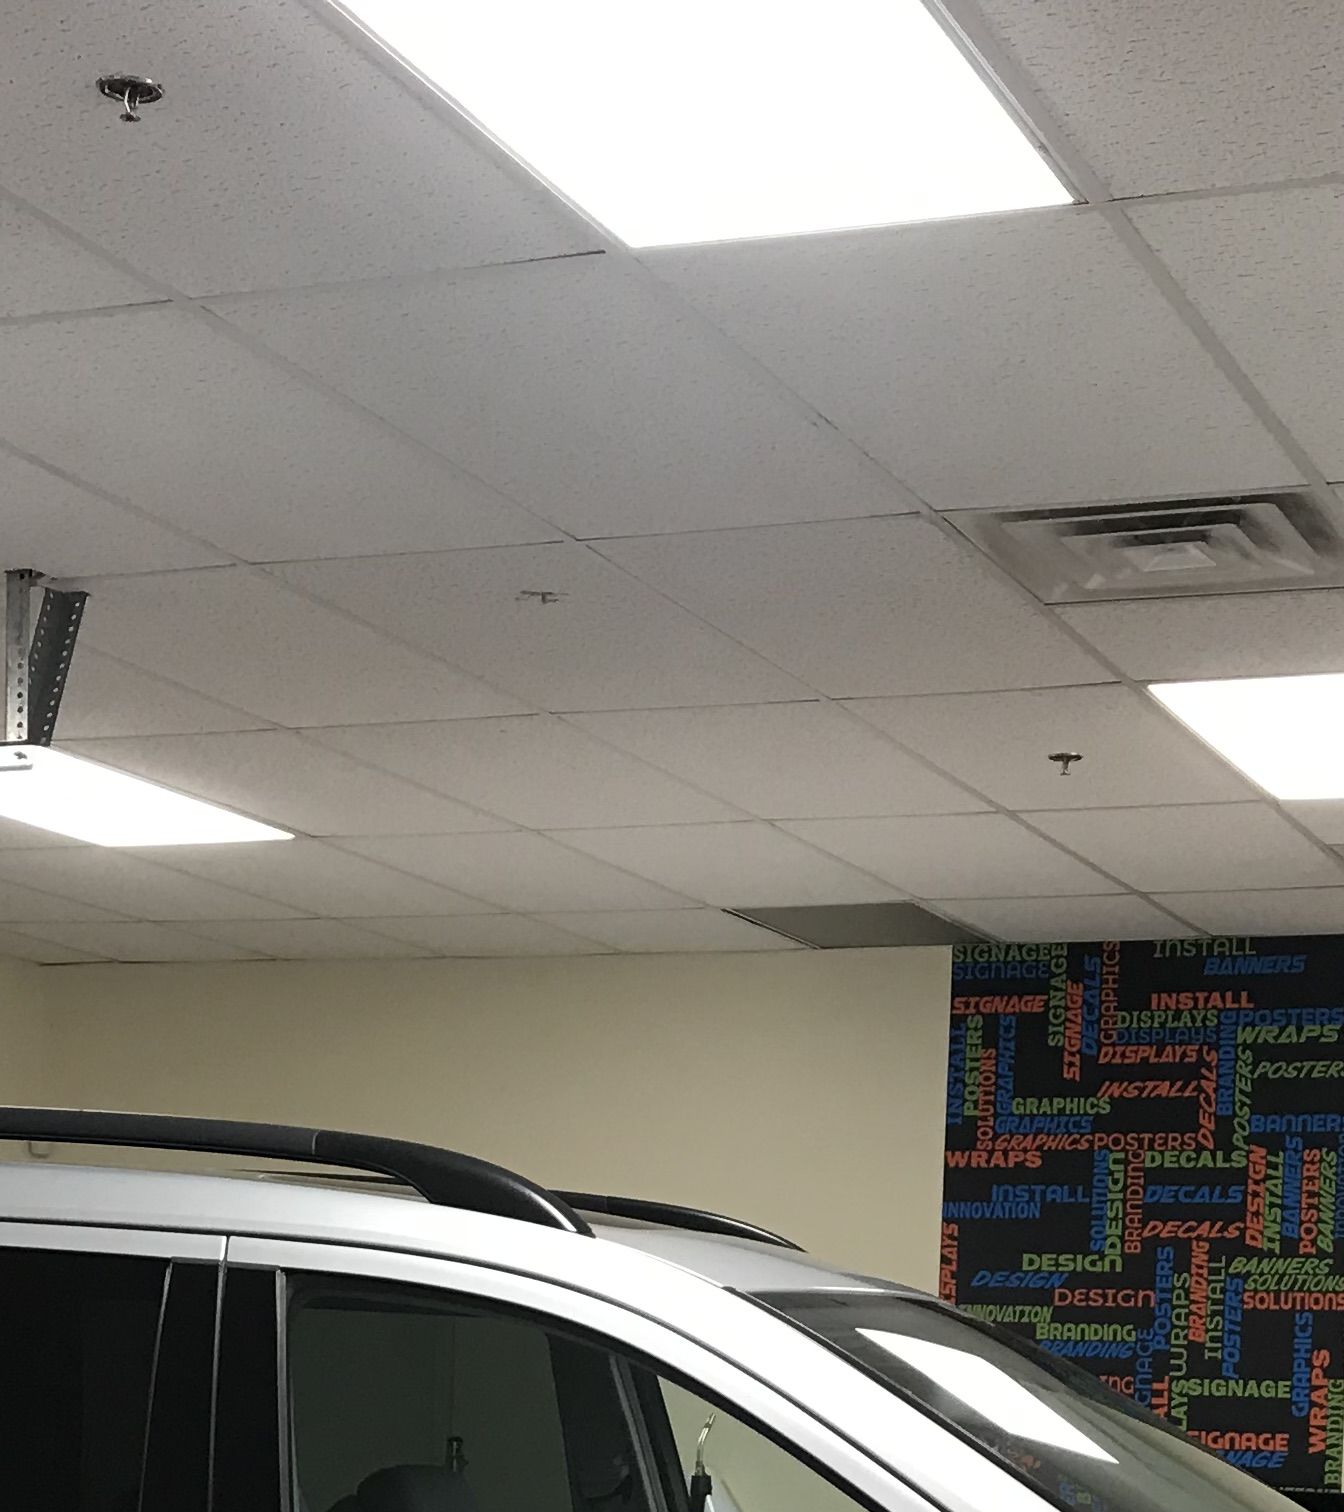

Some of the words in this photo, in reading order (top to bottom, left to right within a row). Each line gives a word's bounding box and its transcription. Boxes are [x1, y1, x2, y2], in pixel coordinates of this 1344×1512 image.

[952, 942, 1050, 962] SIGNAGE
[952, 961, 1049, 980] SIGNAGE
[1153, 937, 1256, 957] INSTALL
[1203, 954, 1307, 976] BANNERS
[952, 994, 1049, 1014] SIGNAGE
[1048, 943, 1067, 1047] SIGNAGE
[1081, 954, 1101, 1056] DECALS
[1099, 940, 1120, 1044] GRAPHICS
[1151, 991, 1255, 1010] INSTALL
[1238, 1007, 1344, 1026] POSTERS
[1063, 980, 1084, 1082] SIGNAGE
[1115, 1010, 1218, 1028] DISPLAYS
[1116, 1027, 1217, 1044] DISPLAYS
[1237, 1024, 1341, 1044] WRAPS
[947, 1022, 966, 1125] INSTALL
[964, 1014, 983, 1116] POSTERS
[996, 1014, 1017, 1115] GRAPHICS
[1097, 1045, 1199, 1064] DISPLAYS
[1217, 1010, 1236, 1116] BRANDING
[976, 1048, 996, 1150] SOLUTIONS
[1012, 1097, 1111, 1115] GRAPHICS
[1096, 1080, 1200, 1099] INSTALL
[1197, 1045, 1217, 1149] DECALS
[1232, 1046, 1253, 1150] POSTERS
[994, 1116, 1094, 1133] GRAPHICS
[994, 1133, 1094, 1150] GRAPHICS
[1093, 1132, 1196, 1150] POSTERS
[945, 1150, 1043, 1168] WRAPS
[1144, 1150, 1248, 1168] DECALS
[942, 1201, 1041, 1219] INNOVATION
[991, 1184, 1089, 1203] INSTALL
[1090, 1149, 1110, 1252] SOLUTIONS
[1105, 1151, 1125, 1254] DESIGN
[1124, 1150, 1145, 1253] BRANDING
[1143, 1185, 1246, 1204] DECALS
[1245, 1144, 1267, 1248] DESIGN
[1264, 1151, 1284, 1254] INSTALL
[1281, 1135, 1303, 1239] BANNERS
[1299, 1149, 1321, 1254] POSTERS
[1317, 1147, 1337, 1253] BANNERS
[1142, 1220, 1245, 1238] DECALS
[939, 1221, 958, 1305] ISPLAYS
[970, 1270, 1069, 1288] DESIGN
[1022, 1253, 1123, 1272] DESIGN
[1228, 1257, 1333, 1275] BANNERS
[1054, 1288, 1155, 1307] DESIGN
[1153, 1246, 1174, 1350] POSTERS
[1188, 1239, 1209, 1343] BRANDING
[1205, 1255, 1226, 1360] INSTALL
[1036, 1323, 1137, 1341] BRANDING
[1169, 1272, 1190, 1376] WRAPS
[1221, 1276, 1244, 1379] POSTERS
[1136, 1327, 1154, 1407] GNAGE
[1186, 1378, 1292, 1398] SIGNAGE
[1291, 1311, 1313, 1417] GRAPHICS
[1308, 1349, 1330, 1455] WRAPS
